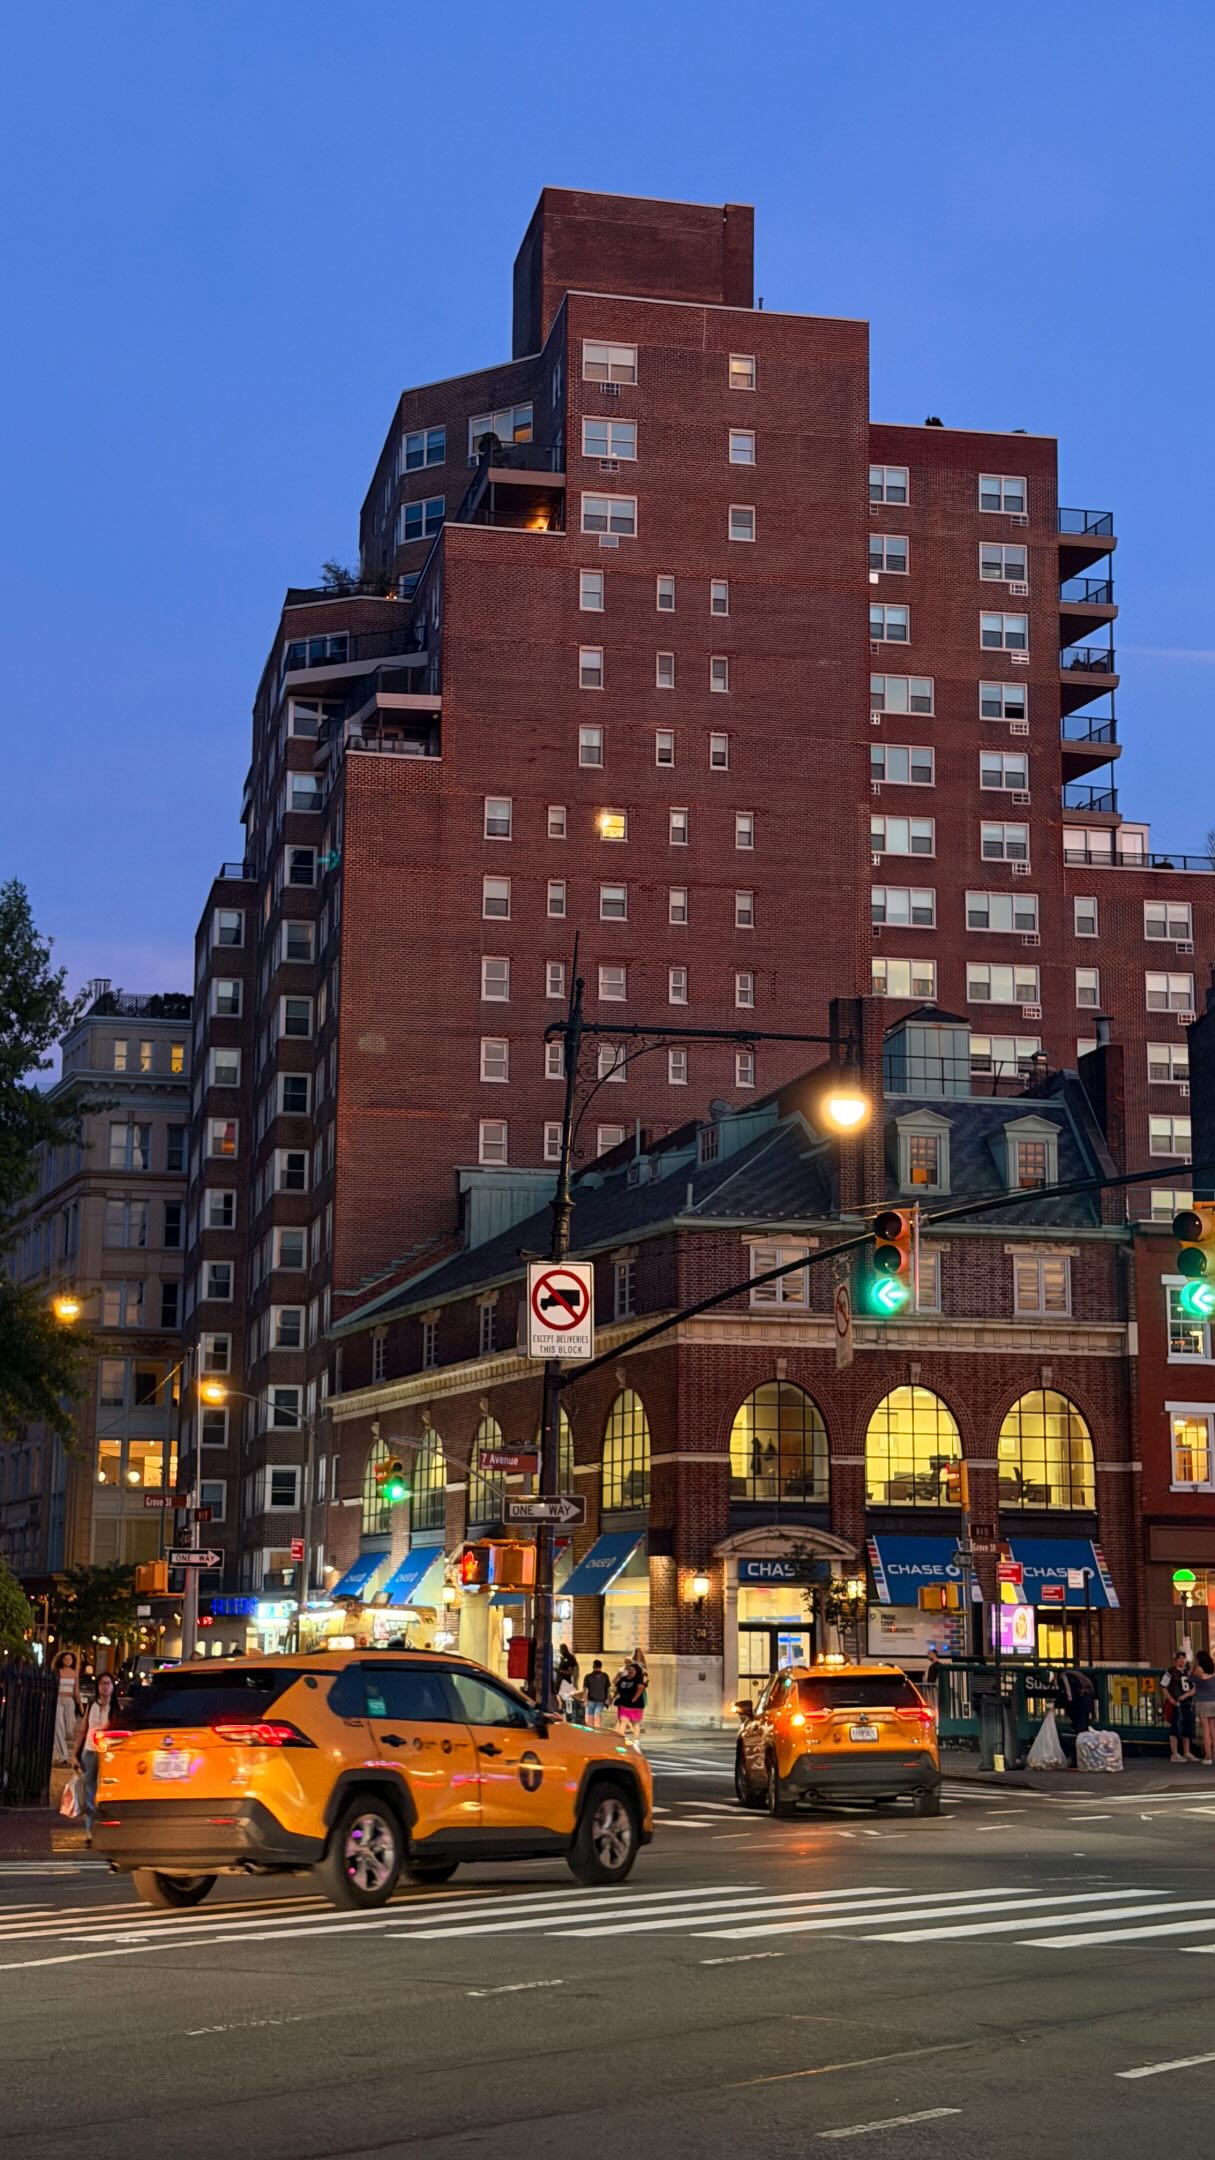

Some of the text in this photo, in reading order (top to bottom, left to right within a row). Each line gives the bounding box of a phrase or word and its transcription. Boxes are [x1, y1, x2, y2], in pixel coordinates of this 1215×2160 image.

[532, 1334, 589, 1344] EXCEPT DELIVERIES
[539, 1345, 583, 1354] THIS BLOCK
[481, 1453, 519, 1466] 7 Avenue
[145, 1496, 172, 1507] Grove St
[512, 1505, 572, 1516] ONE WAY
[175, 1554, 191, 1562] ONE
[747, 1562, 797, 1577] CHAS
[887, 1564, 944, 1575] CHASE
[1023, 1566, 1072, 1578] CHAS
[1181, 1676, 1190, 1691] 6
